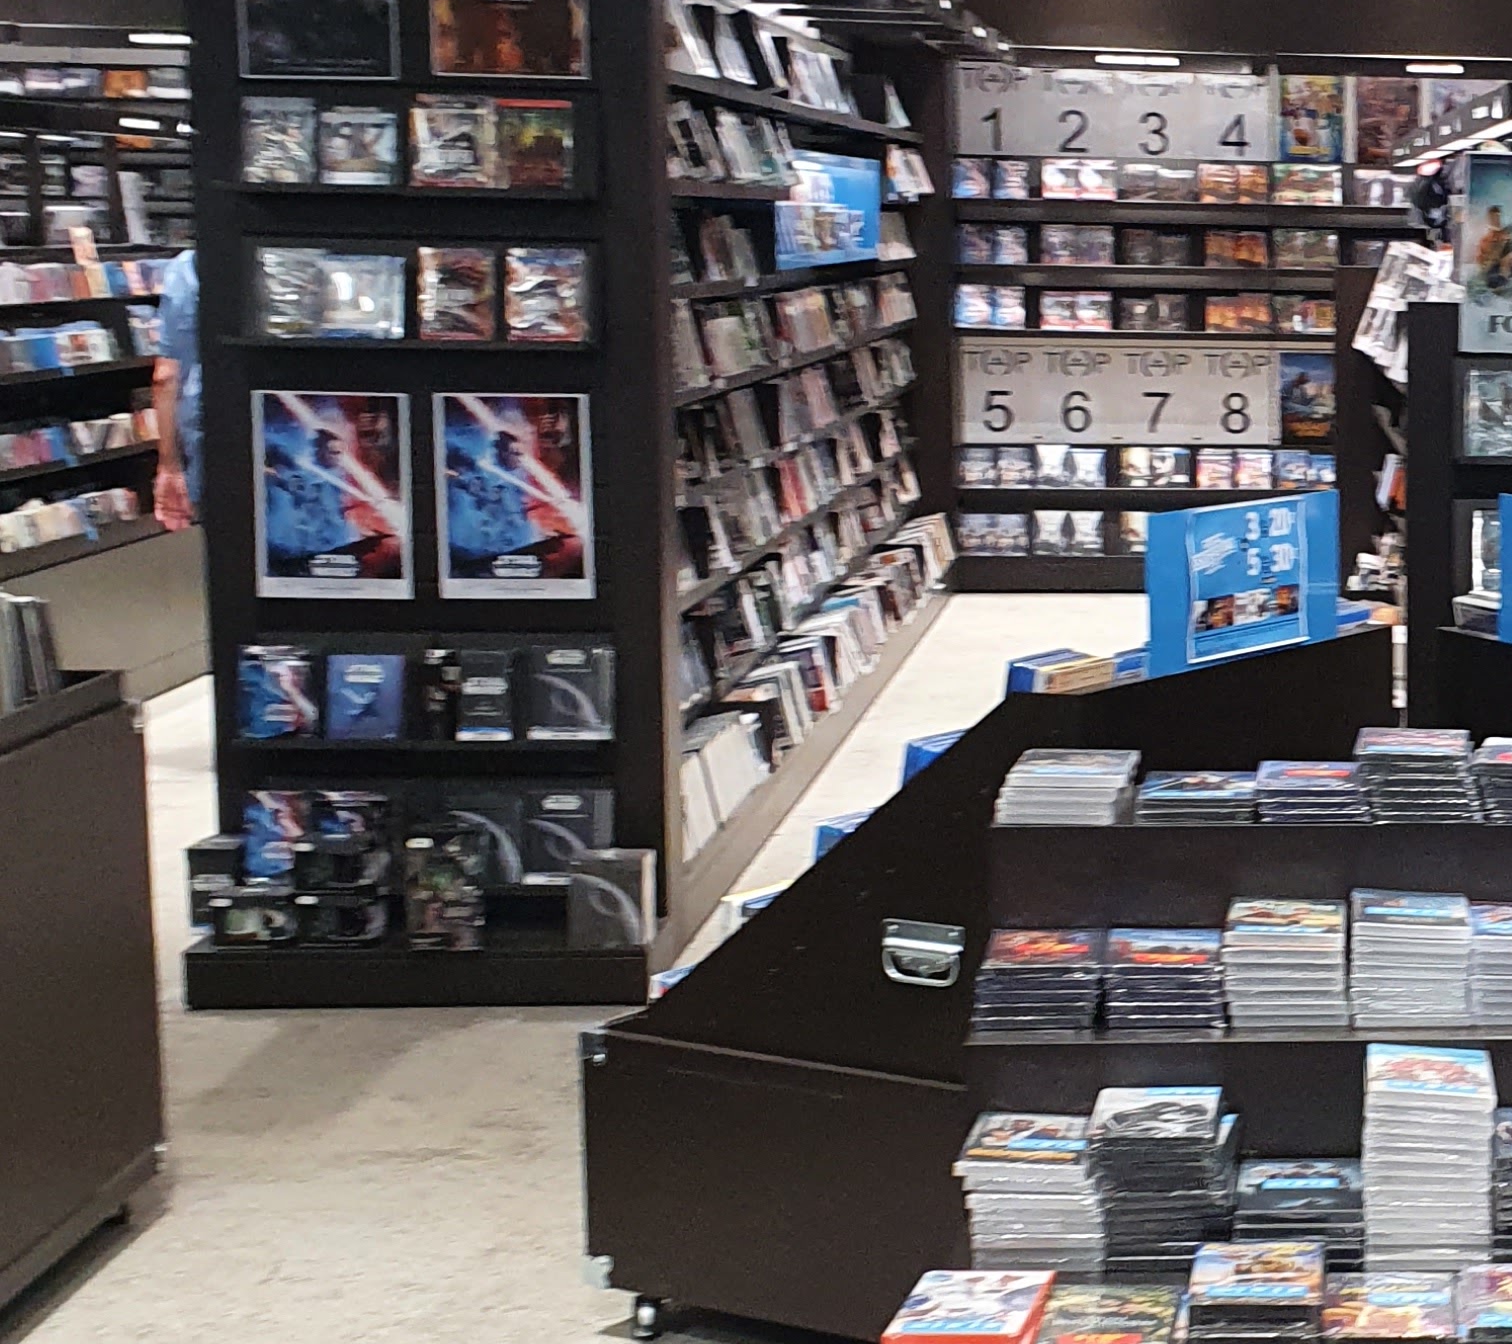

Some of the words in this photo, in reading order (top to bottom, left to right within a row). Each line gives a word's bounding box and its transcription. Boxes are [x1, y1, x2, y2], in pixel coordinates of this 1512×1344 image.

[979, 107, 1003, 153] 1
[1057, 109, 1091, 154] 2
[1137, 111, 1170, 156] 3
[1216, 113, 1251, 157] 4
[982, 389, 1016, 433] 5
[1060, 390, 1093, 433] 6
[1141, 391, 1175, 434] 7
[1219, 392, 1251, 435] 8
